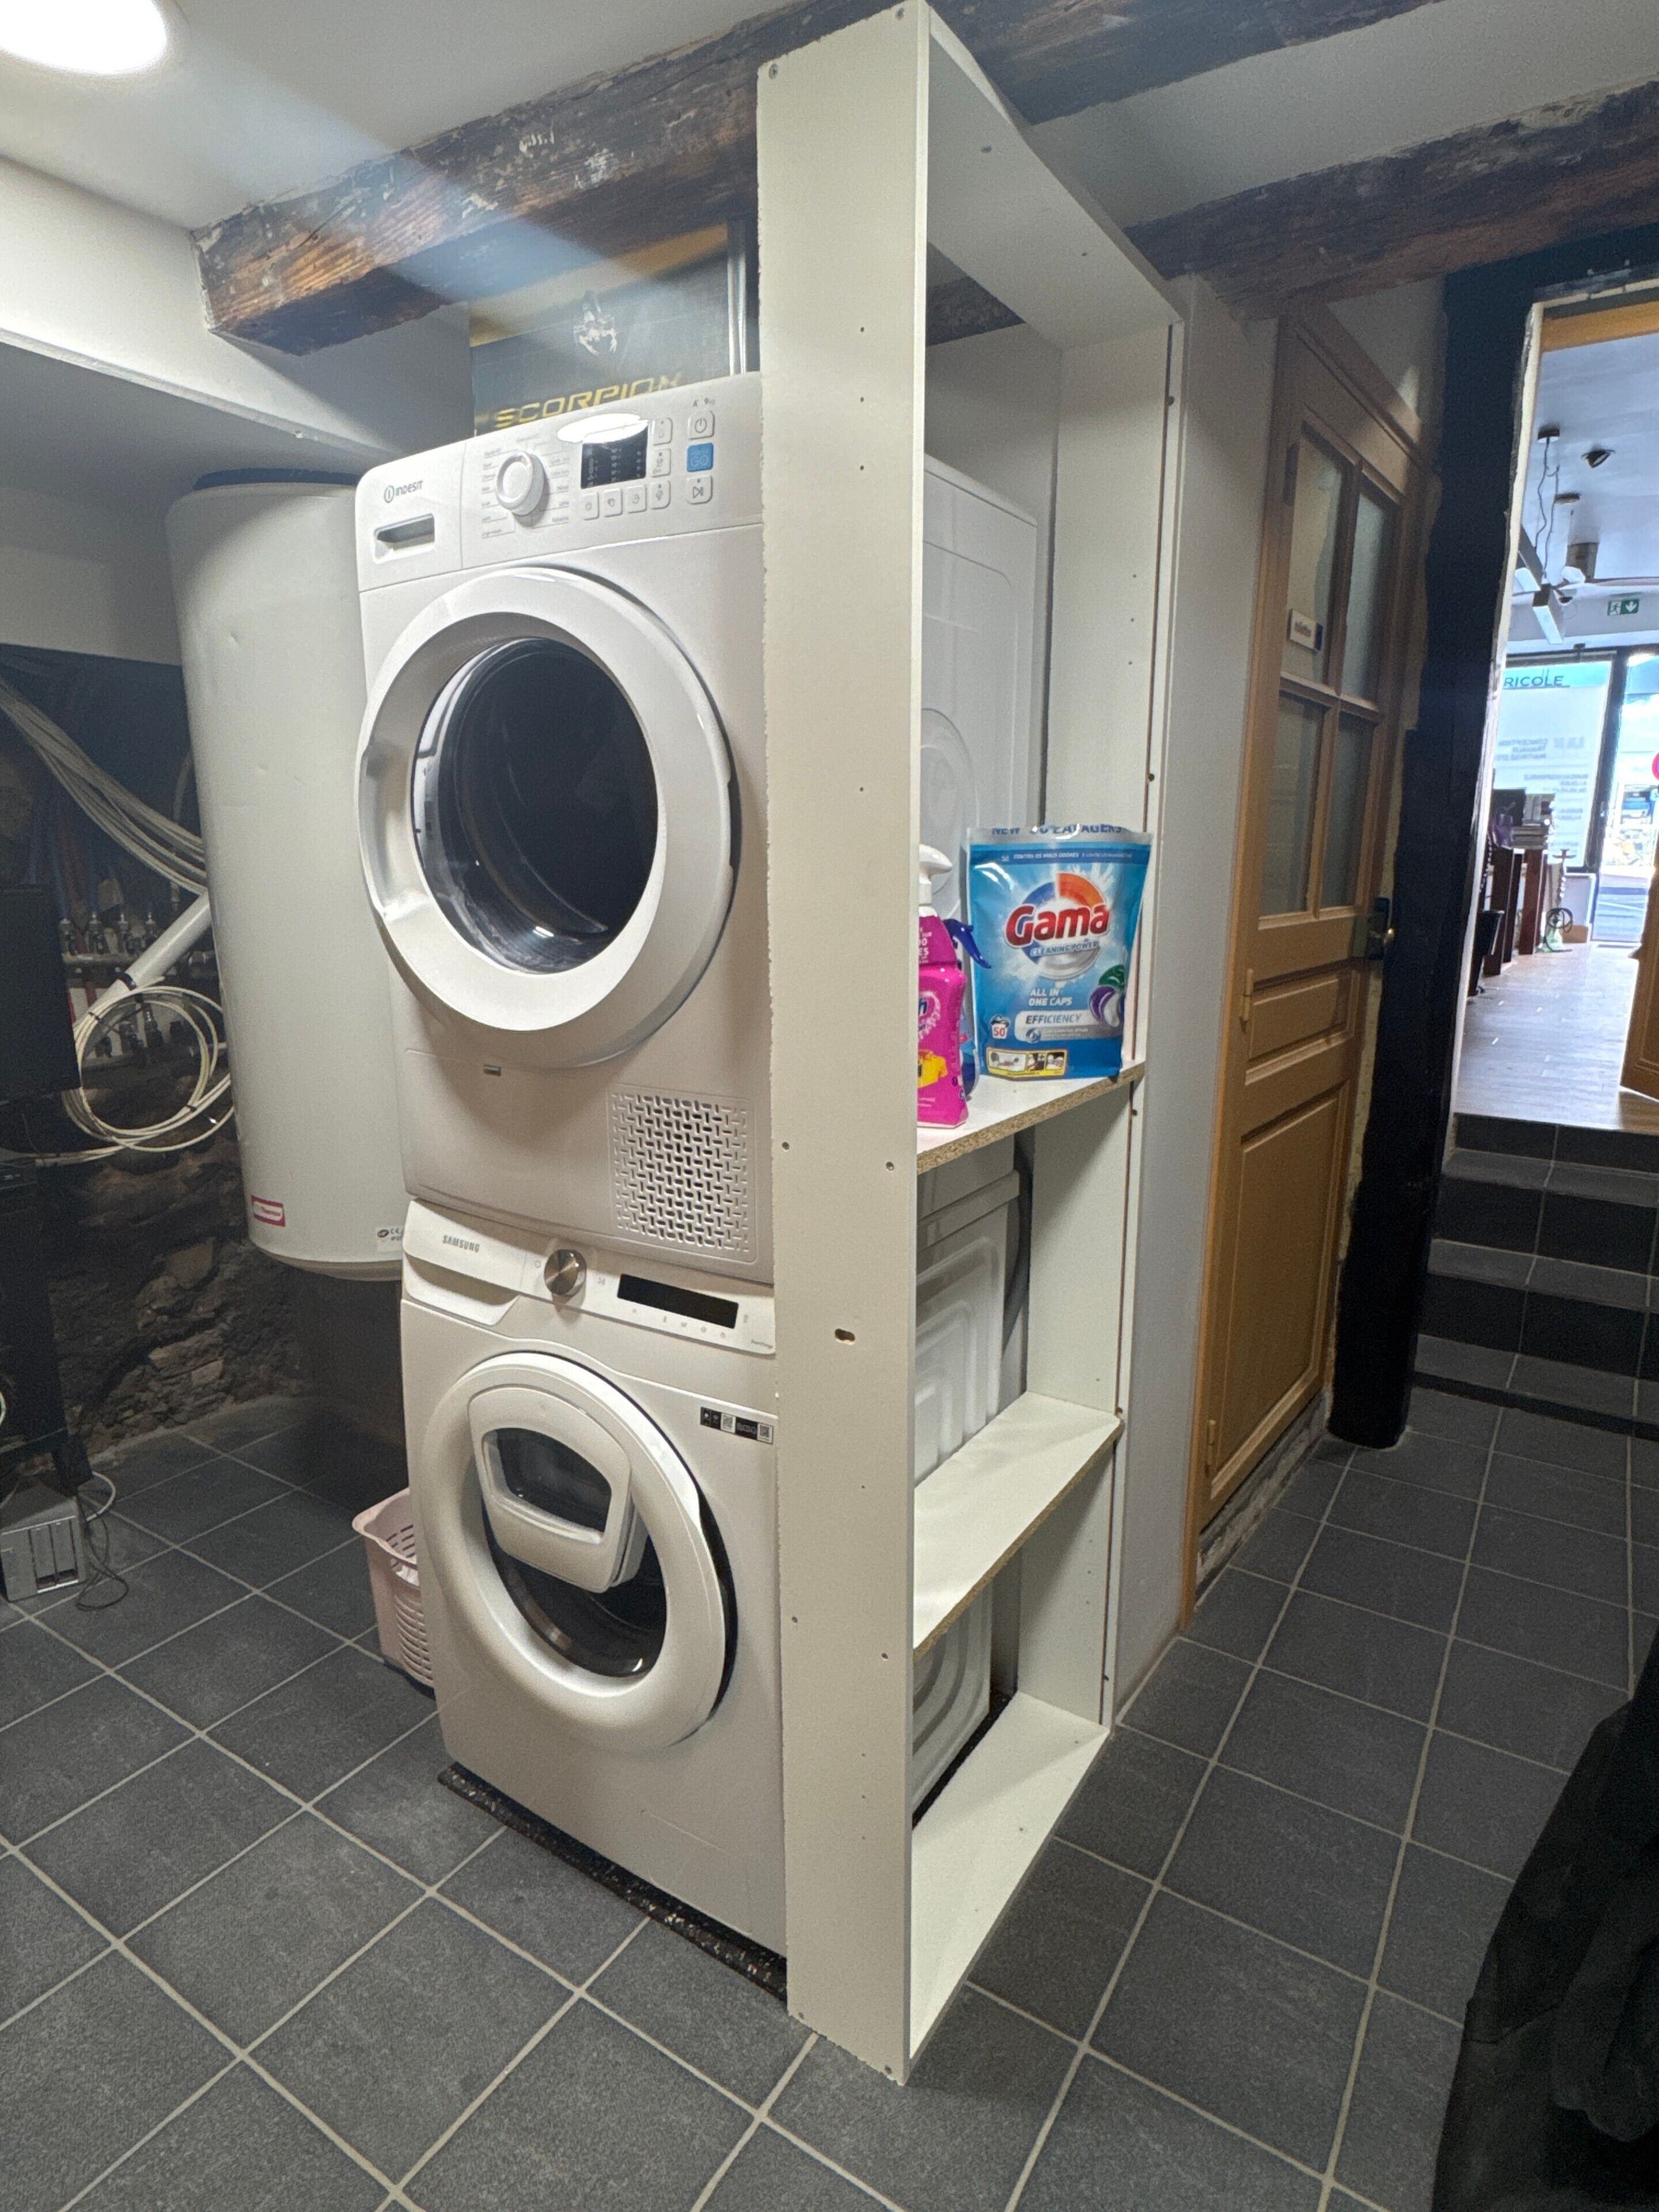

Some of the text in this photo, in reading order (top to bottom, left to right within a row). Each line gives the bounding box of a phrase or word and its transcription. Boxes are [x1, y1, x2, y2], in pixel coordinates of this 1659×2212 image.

[1005, 904, 1110, 948] Gama
[1031, 945, 1070, 957] CLEANING
[1029, 988, 1060, 997] ALL IN
[1028, 997, 1073, 1006] ONE CAPS
[1025, 1013, 1082, 1025] EFFICIENCY
[993, 1027, 1005, 1037] 50
[442, 1234, 480, 1253] SAMSUNG
